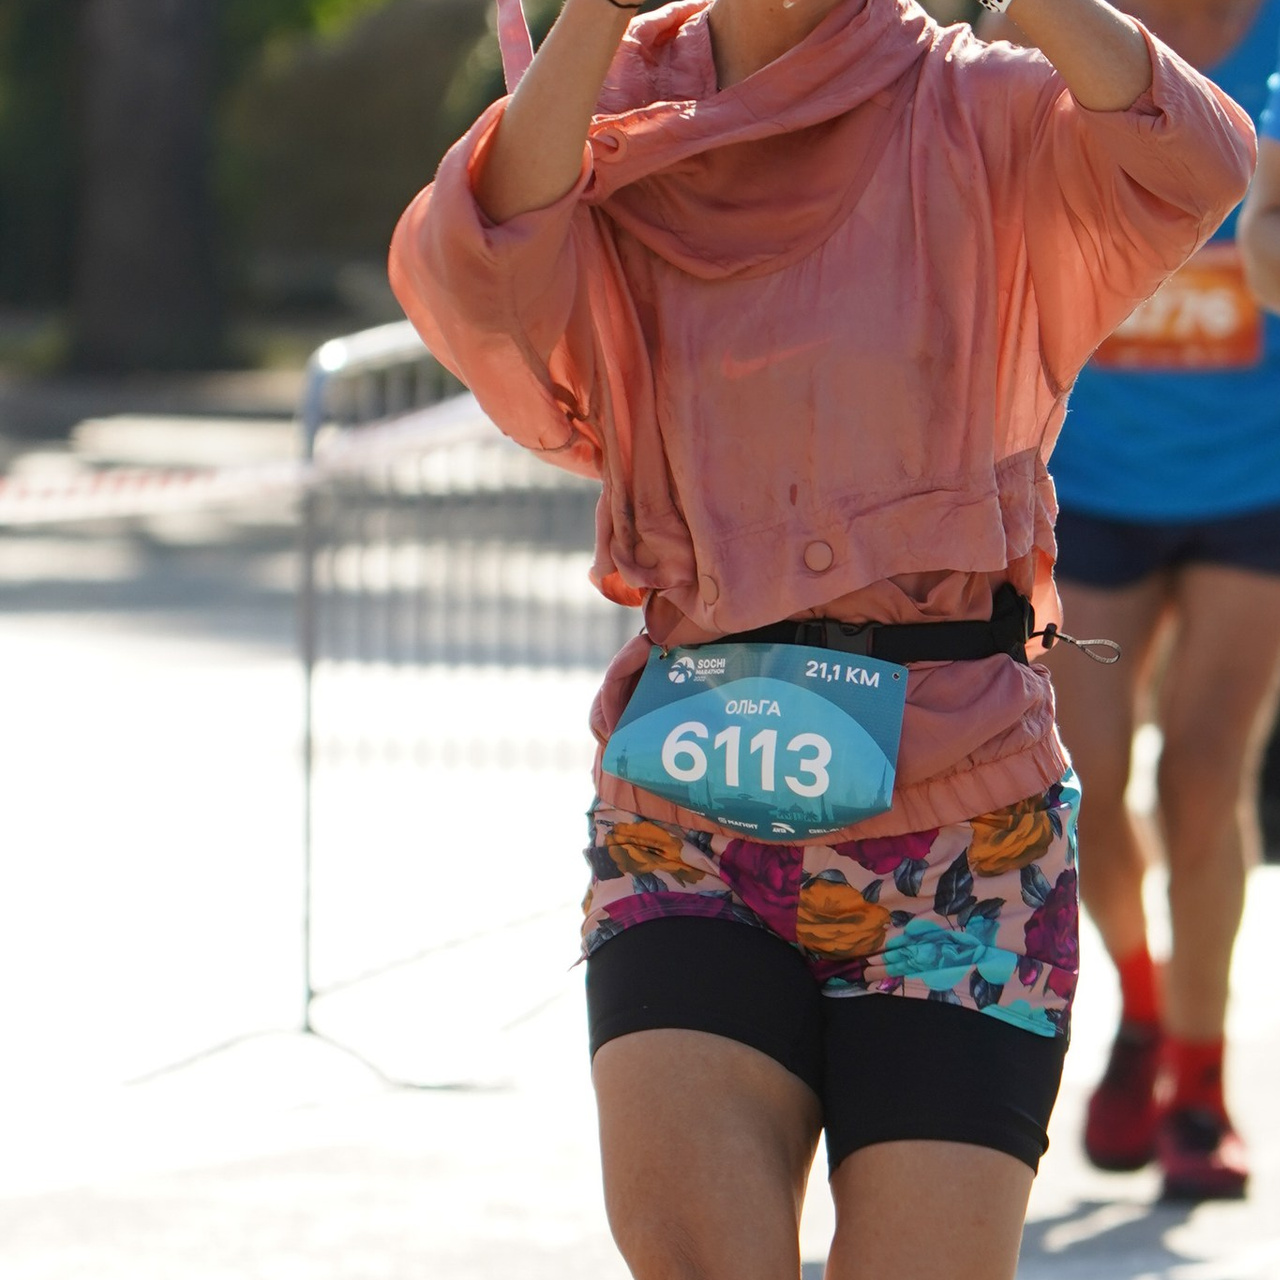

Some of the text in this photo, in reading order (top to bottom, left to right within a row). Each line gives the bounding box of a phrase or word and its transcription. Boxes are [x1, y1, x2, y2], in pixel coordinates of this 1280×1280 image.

[697, 658, 726, 669] SOCHI
[805, 660, 841, 683] 21,1
[725, 699, 781, 717] ОЛЬГА
[661, 721, 832, 797] 6113
